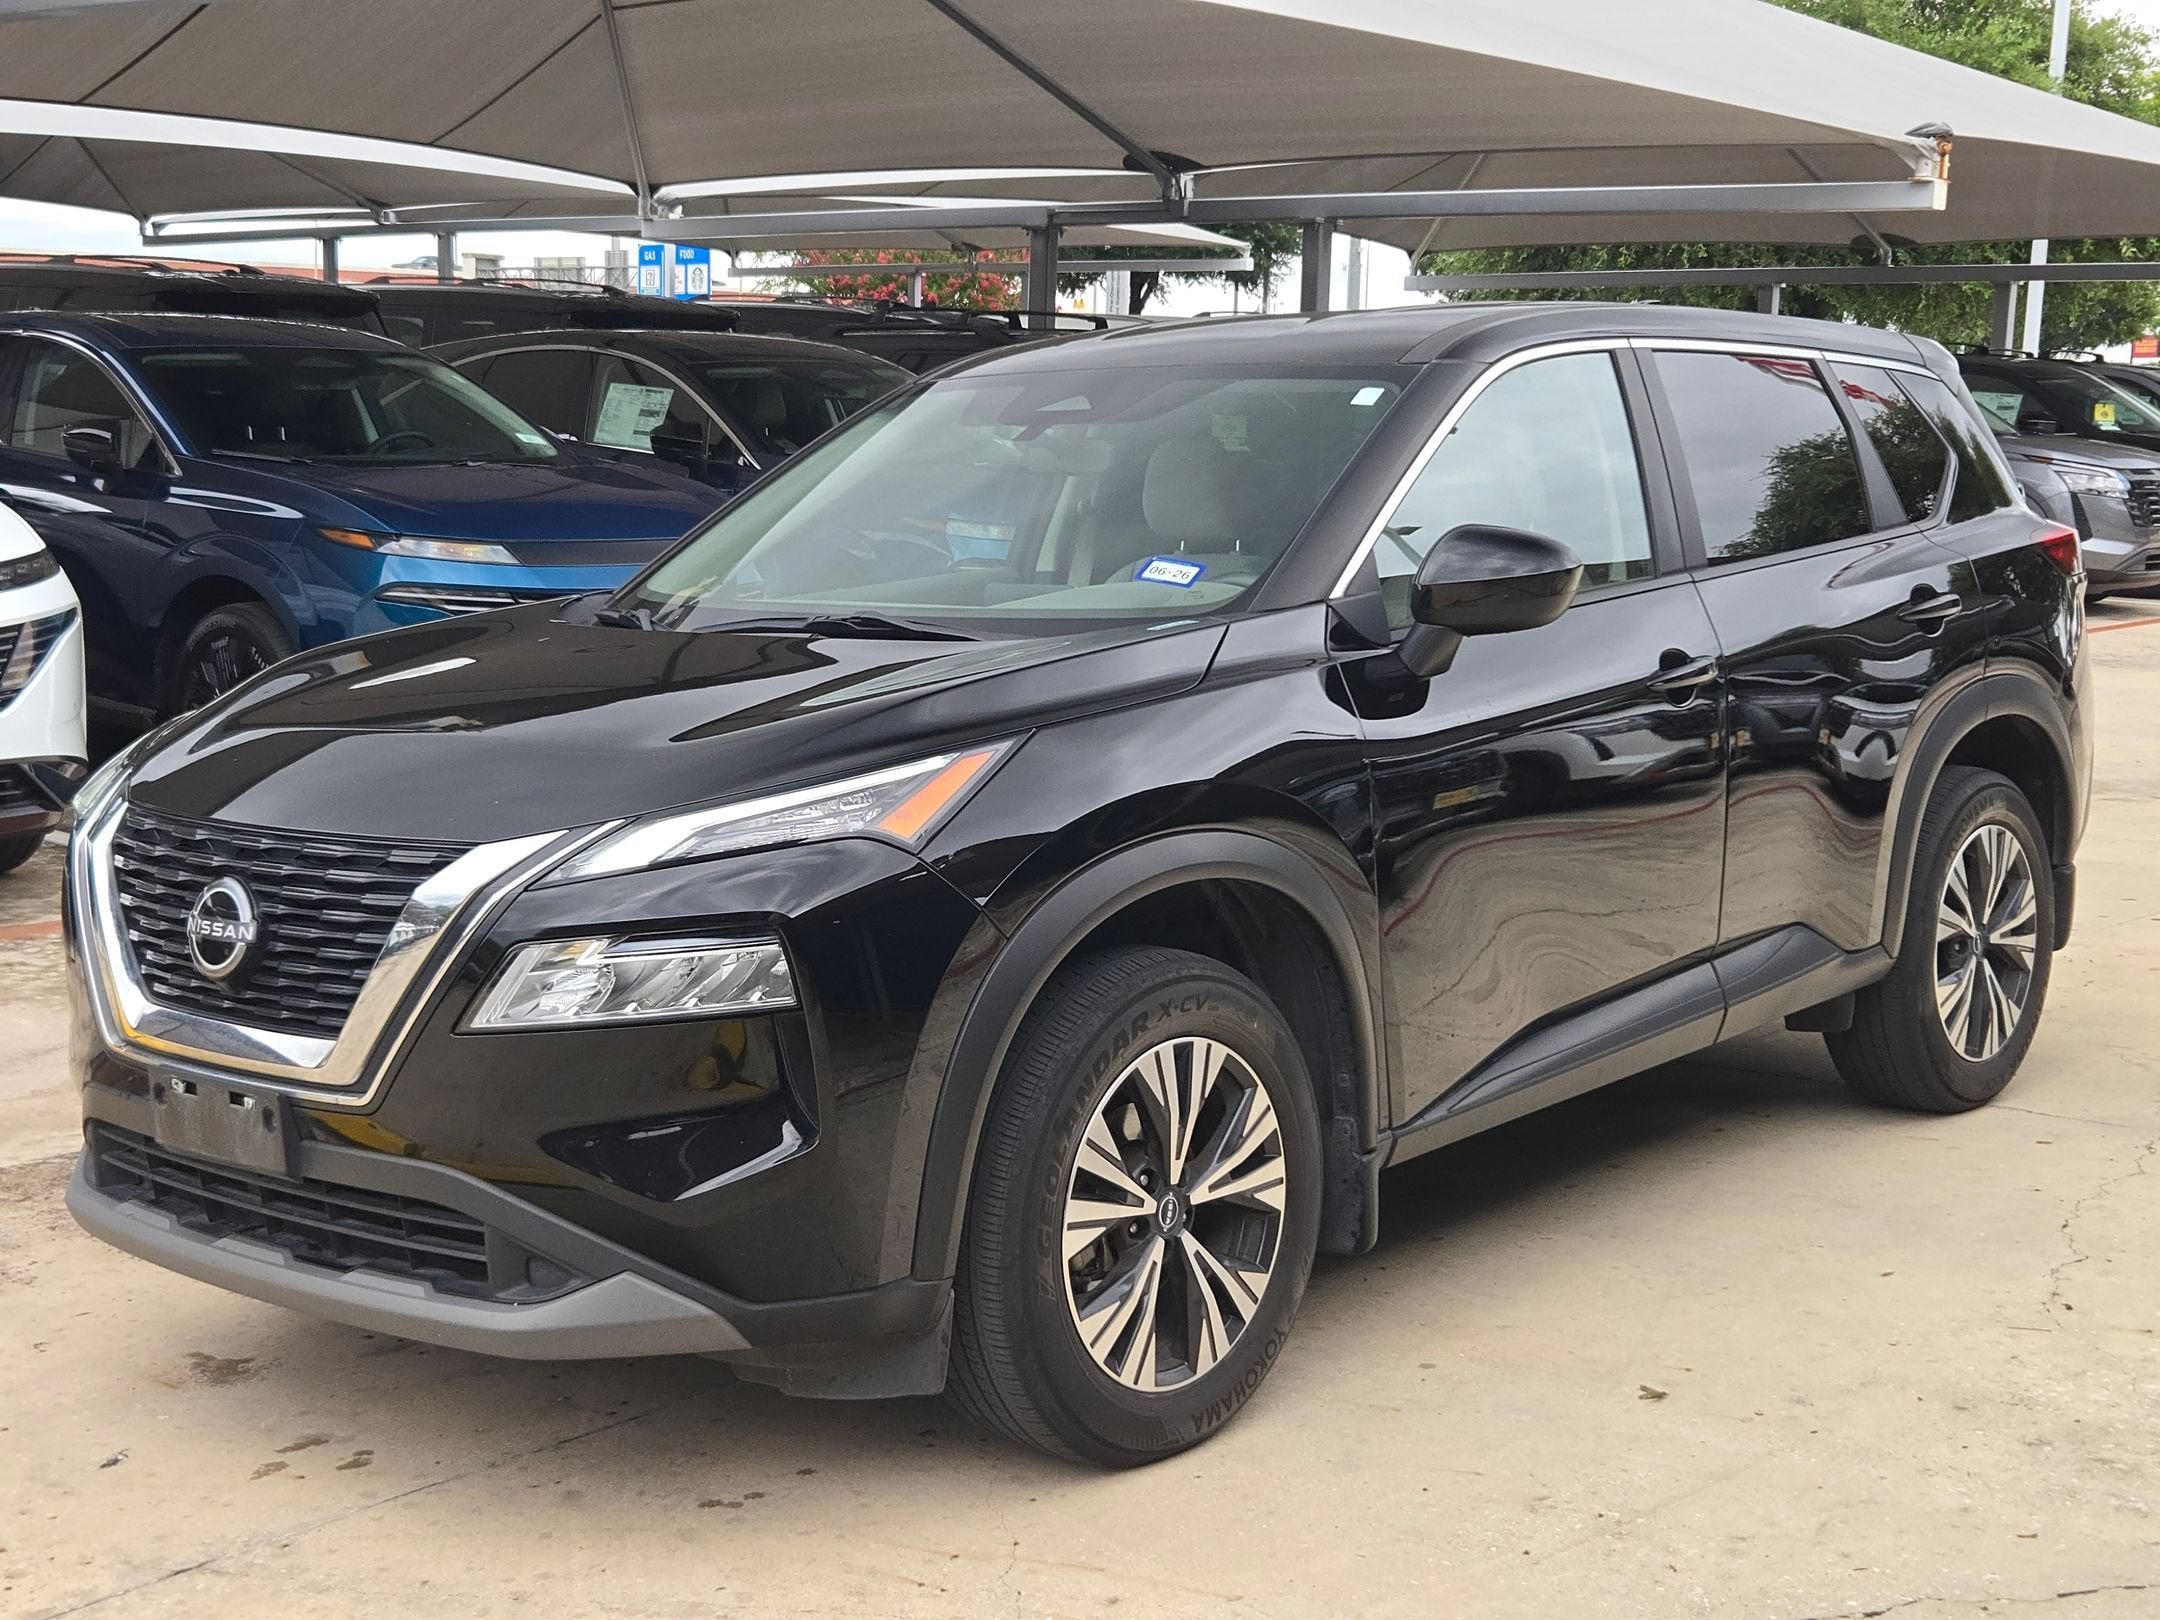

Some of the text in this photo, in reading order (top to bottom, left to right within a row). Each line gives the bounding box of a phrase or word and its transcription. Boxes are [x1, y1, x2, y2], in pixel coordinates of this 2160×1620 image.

[644, 250, 656, 261] GAS
[187, 915, 254, 941] NISSAN
[1192, 1327, 1286, 1433] YOKOHAMA
